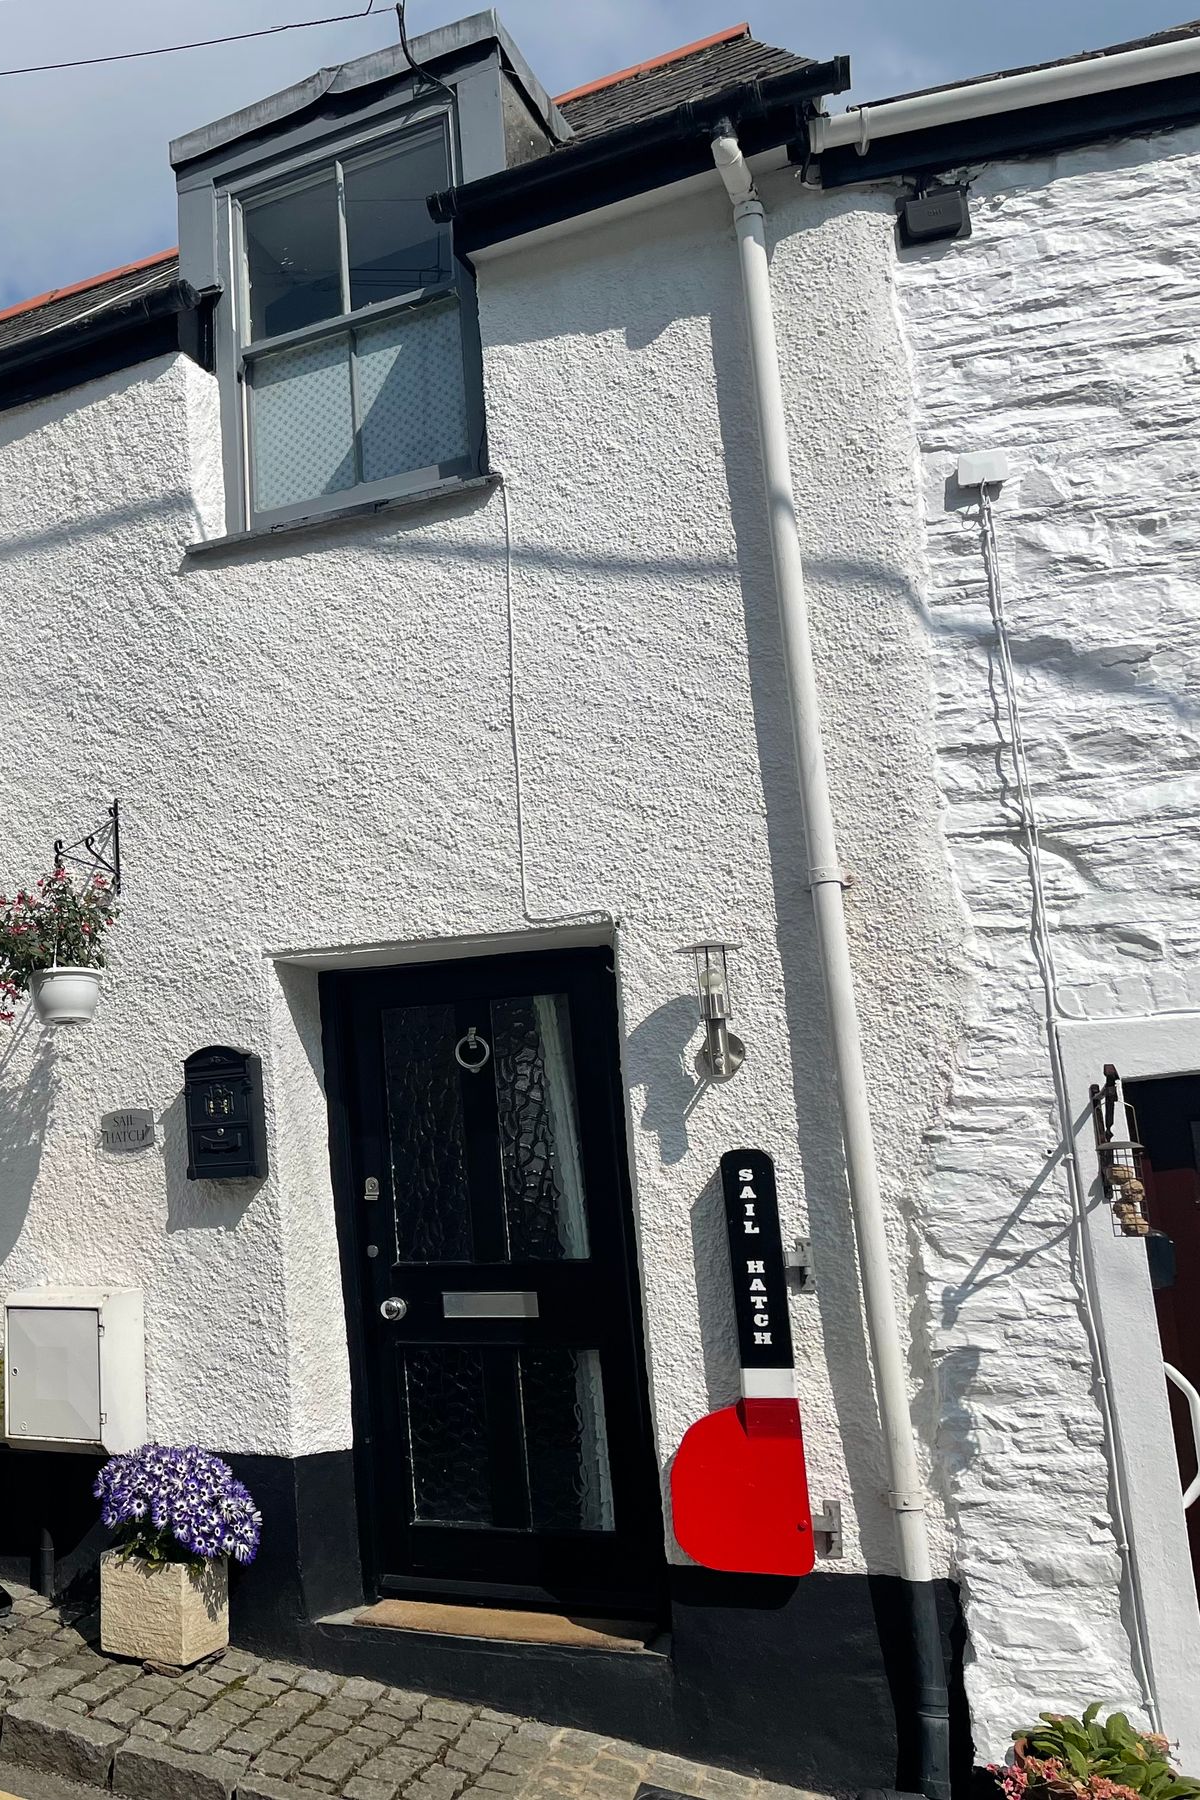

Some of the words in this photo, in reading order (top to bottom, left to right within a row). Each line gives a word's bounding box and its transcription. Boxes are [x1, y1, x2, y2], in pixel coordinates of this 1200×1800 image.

[105, 1129, 145, 1144] HATCH
[738, 1168, 760, 1234] SAIL
[746, 1260, 773, 1345] HATCH
